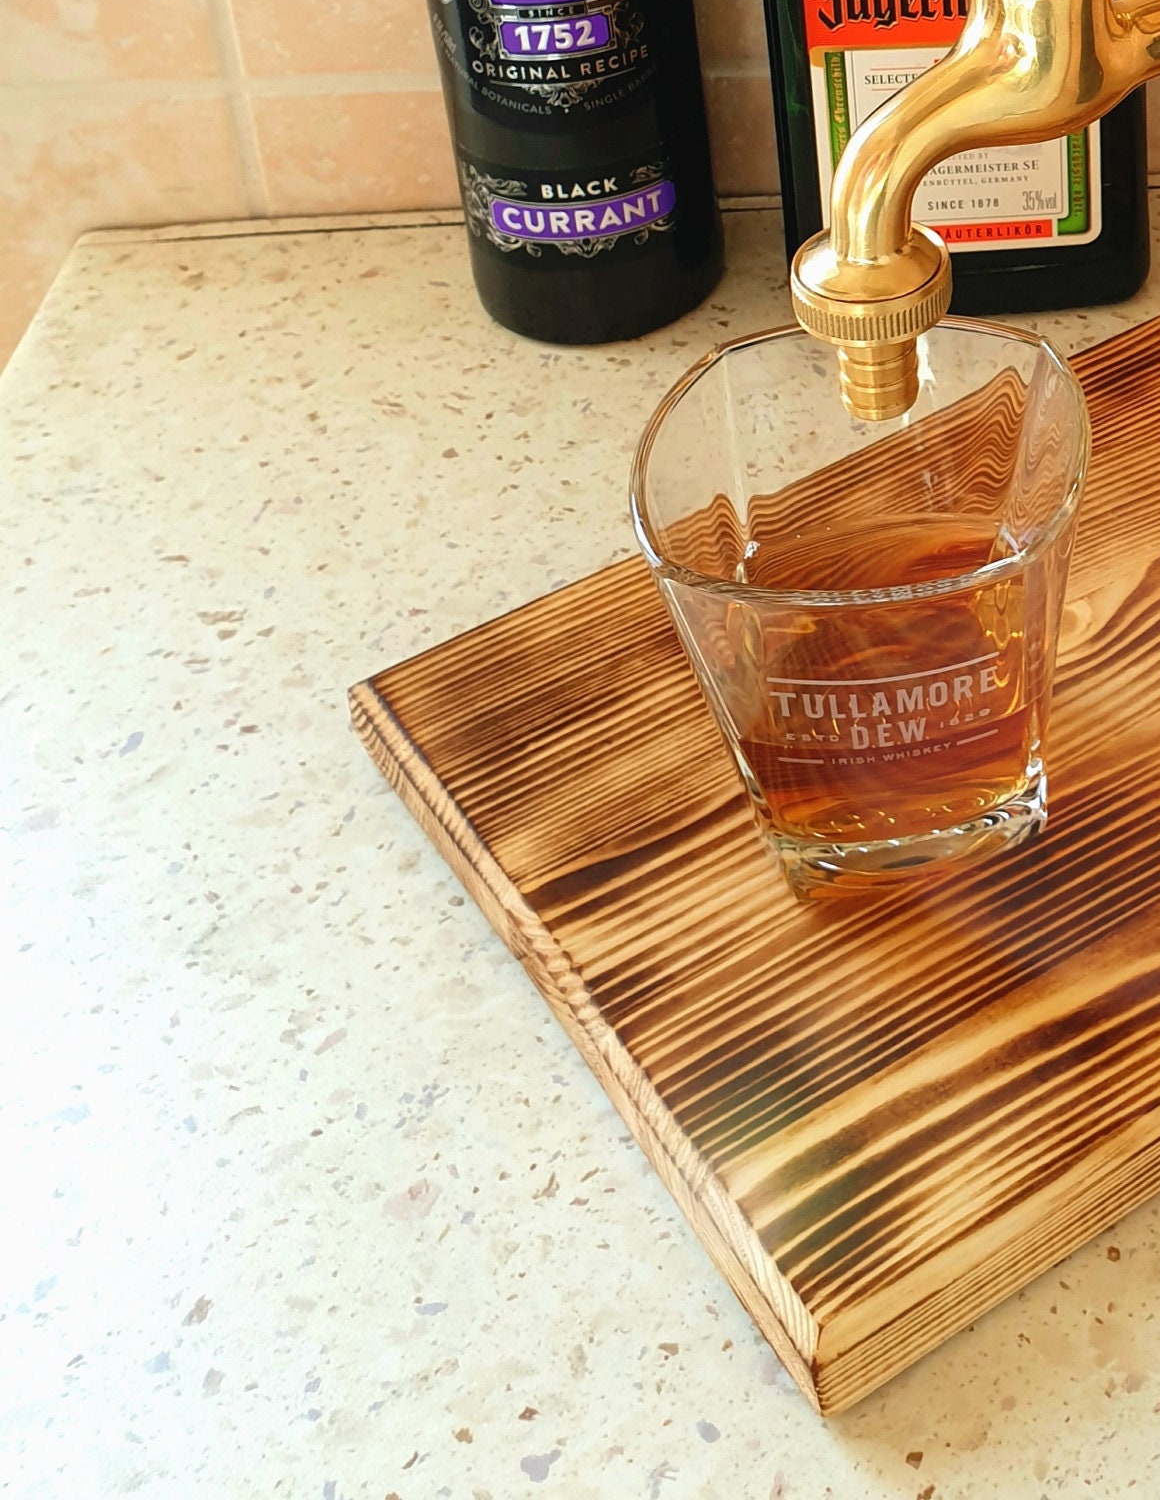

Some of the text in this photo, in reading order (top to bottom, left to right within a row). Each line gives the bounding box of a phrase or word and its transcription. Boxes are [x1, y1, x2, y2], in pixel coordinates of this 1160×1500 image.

[527, 6, 576, 18] SINCE
[514, 20, 596, 52] 1752
[472, 44, 649, 81] ORIGINAL RECIPE
[481, 86, 553, 115] BOTANICALS
[583, 88, 627, 112] SINGLE
[1022, 160, 1040, 171] SE
[540, 177, 619, 199] BLACK
[981, 176, 1029, 185] GERMANY
[502, 189, 662, 234] CURRANT
[928, 198, 1000, 211] SINCE 1878
[769, 665, 999, 720] TULLAMORE
[852, 717, 930, 751] D.E.W.
[831, 742, 952, 766] IRISH WHISKEY
